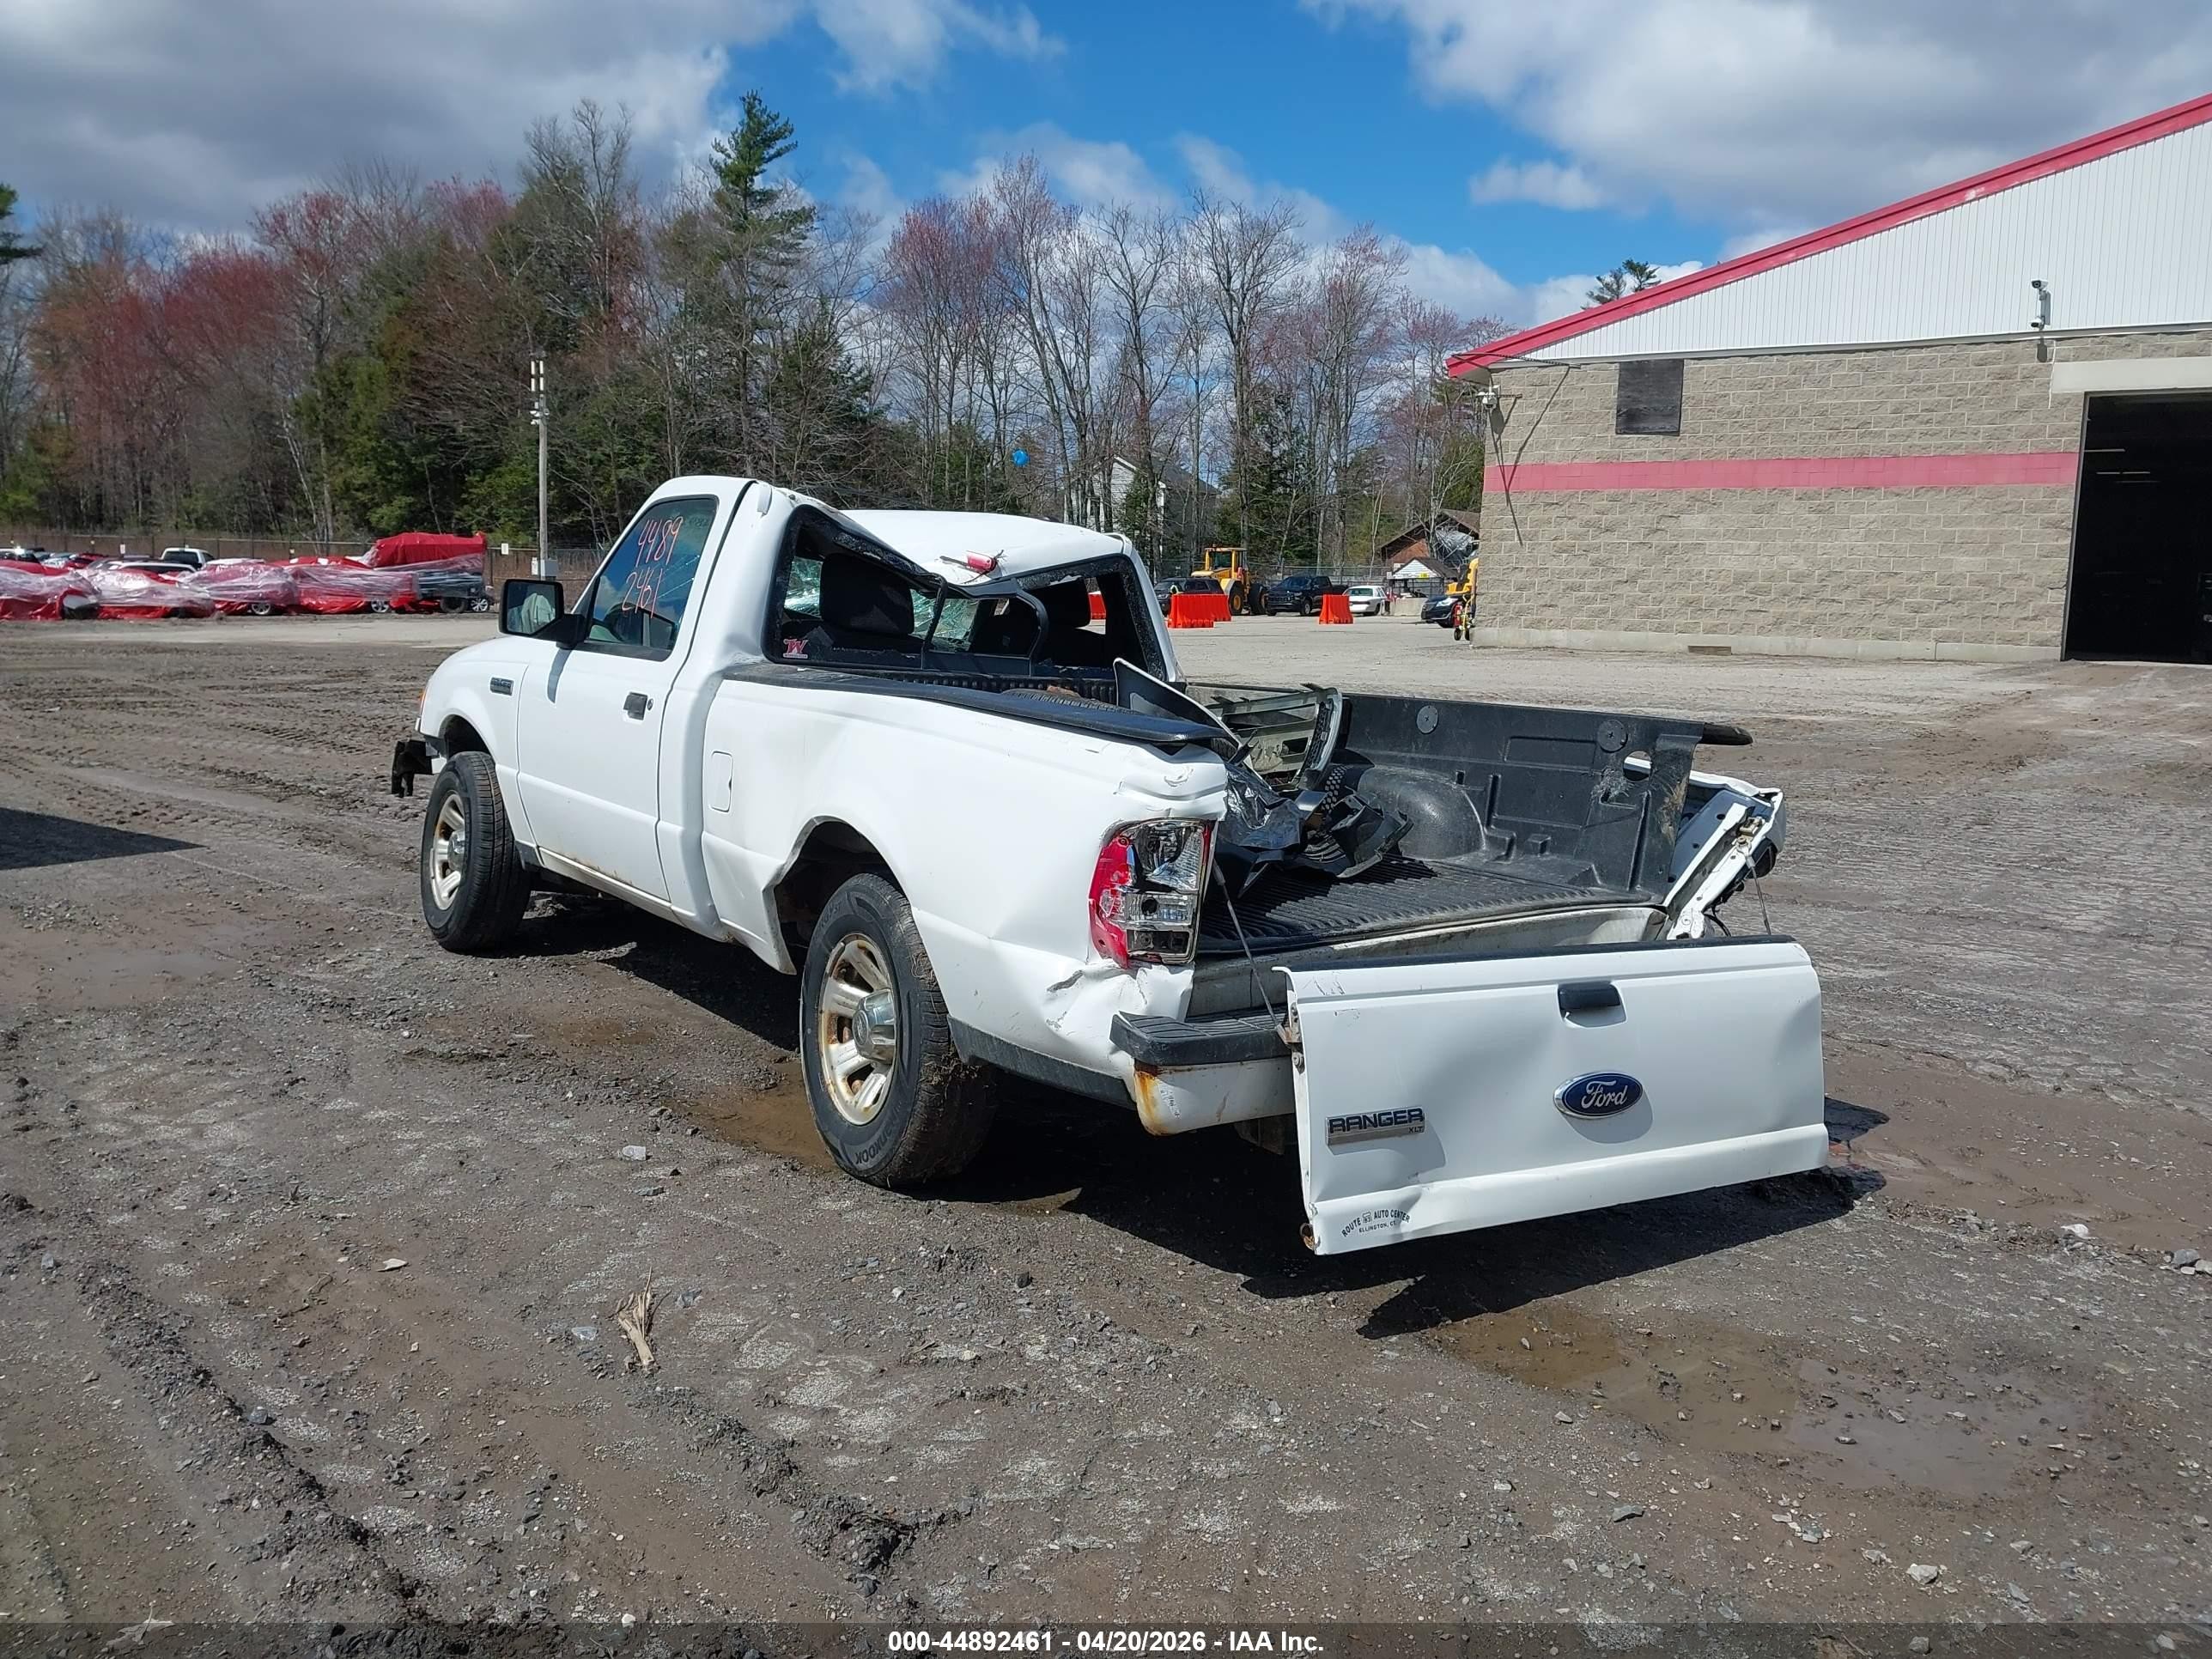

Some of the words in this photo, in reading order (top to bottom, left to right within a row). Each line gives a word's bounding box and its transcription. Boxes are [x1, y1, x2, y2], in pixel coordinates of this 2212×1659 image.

[635, 516, 684, 568] 4489
[622, 566, 663, 619] 2461
[1581, 1080, 1628, 1109] Ford
[1328, 1108, 1425, 1133] RANGER
[1408, 1126, 1424, 1134] XLT
[1341, 1217, 1362, 1237] ROUTE
[1374, 1209, 1389, 1219] AUTO
[1390, 1209, 1411, 1224] CENTER
